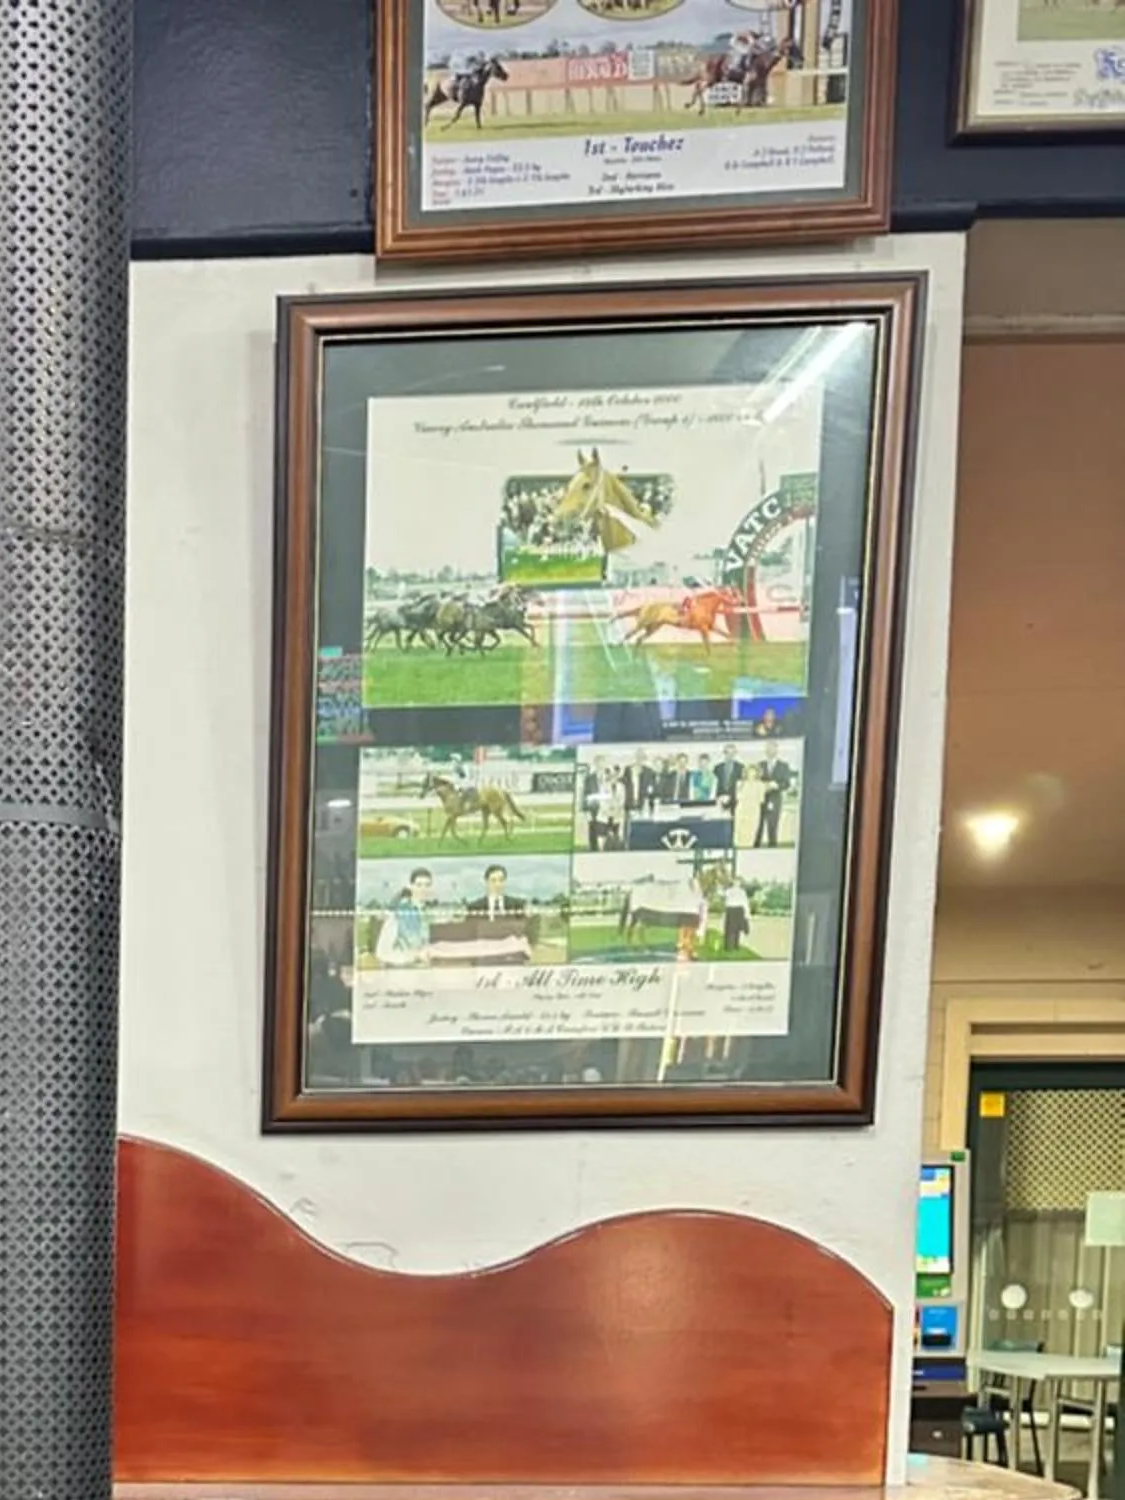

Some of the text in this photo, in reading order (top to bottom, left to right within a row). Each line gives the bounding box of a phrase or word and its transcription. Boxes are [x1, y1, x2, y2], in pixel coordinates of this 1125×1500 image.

[516, 968, 556, 989] All
[555, 967, 606, 989] Time
[608, 966, 662, 991] High
